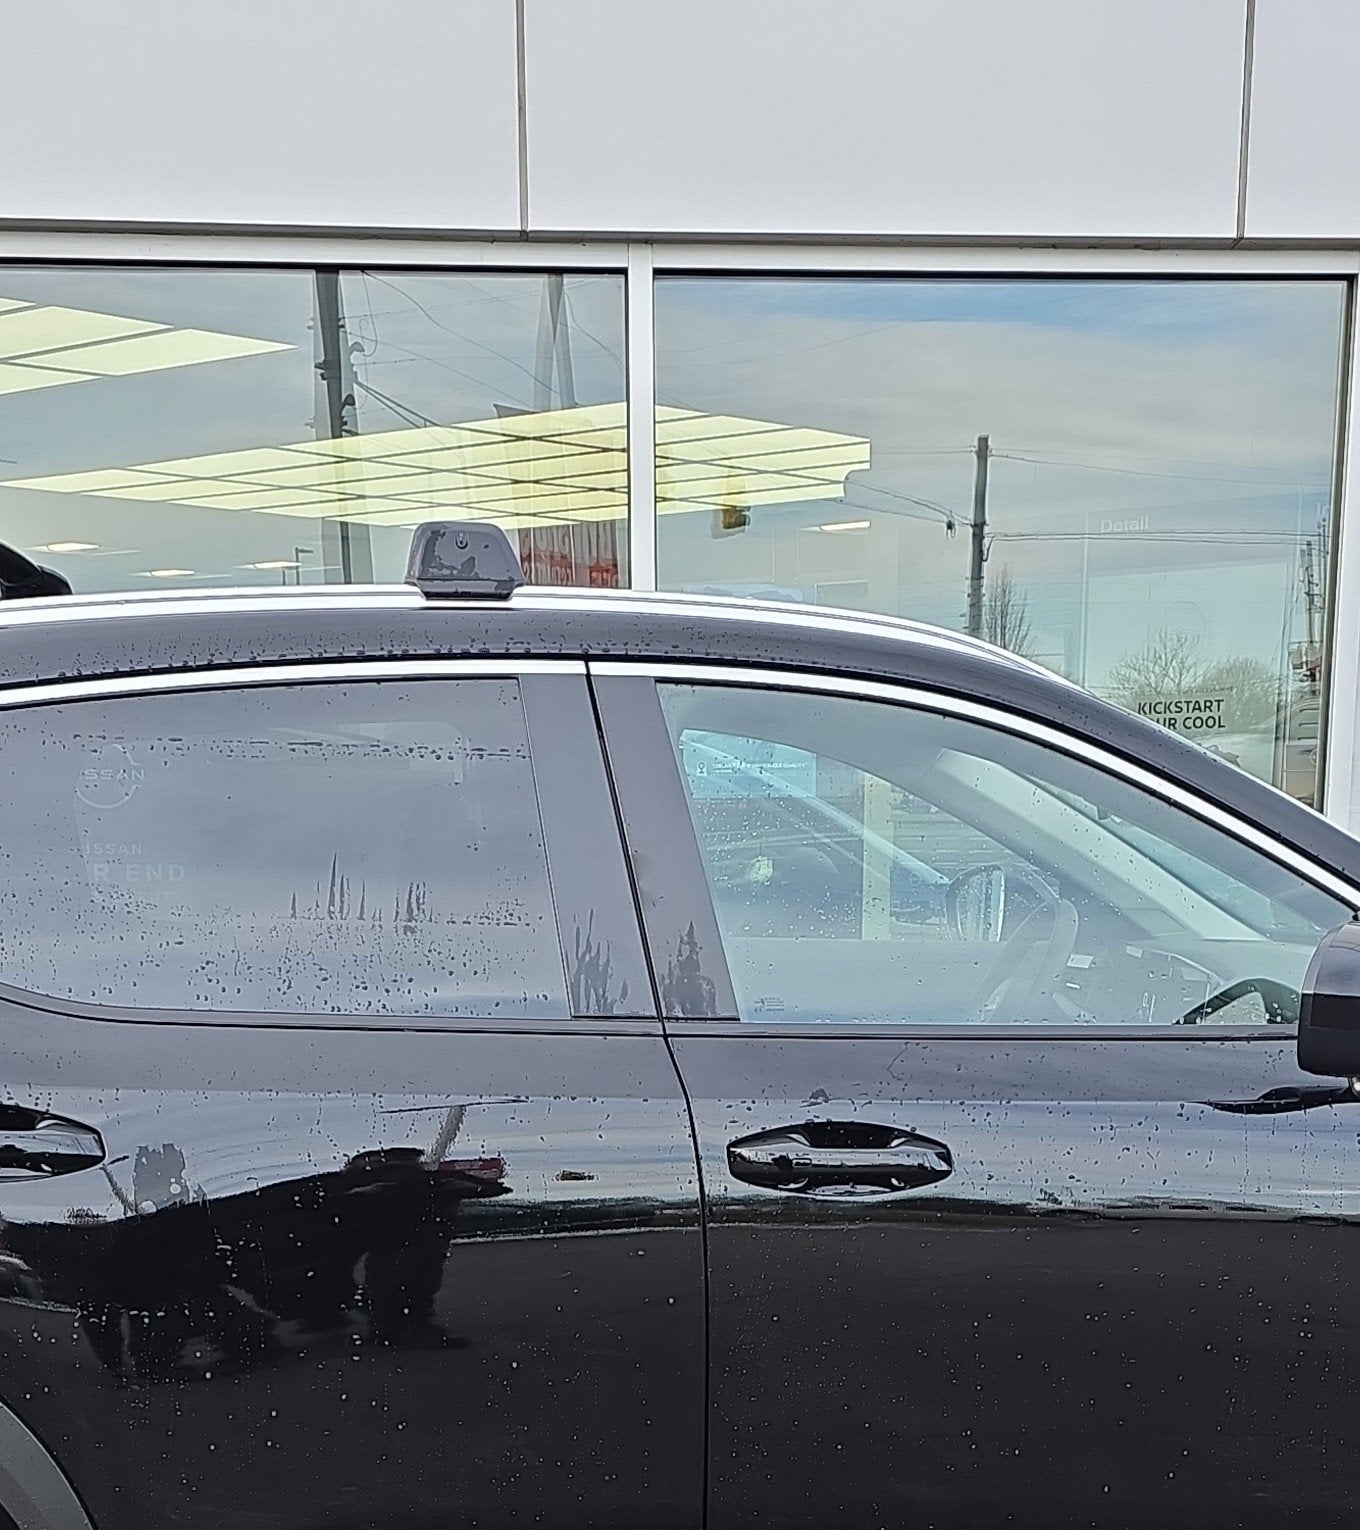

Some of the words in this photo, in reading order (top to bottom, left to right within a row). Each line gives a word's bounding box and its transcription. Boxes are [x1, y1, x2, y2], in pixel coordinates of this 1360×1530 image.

[1100, 515, 1149, 532] Detail
[1137, 699, 1225, 715] KICKSTART
[1182, 715, 1226, 730] COOL
